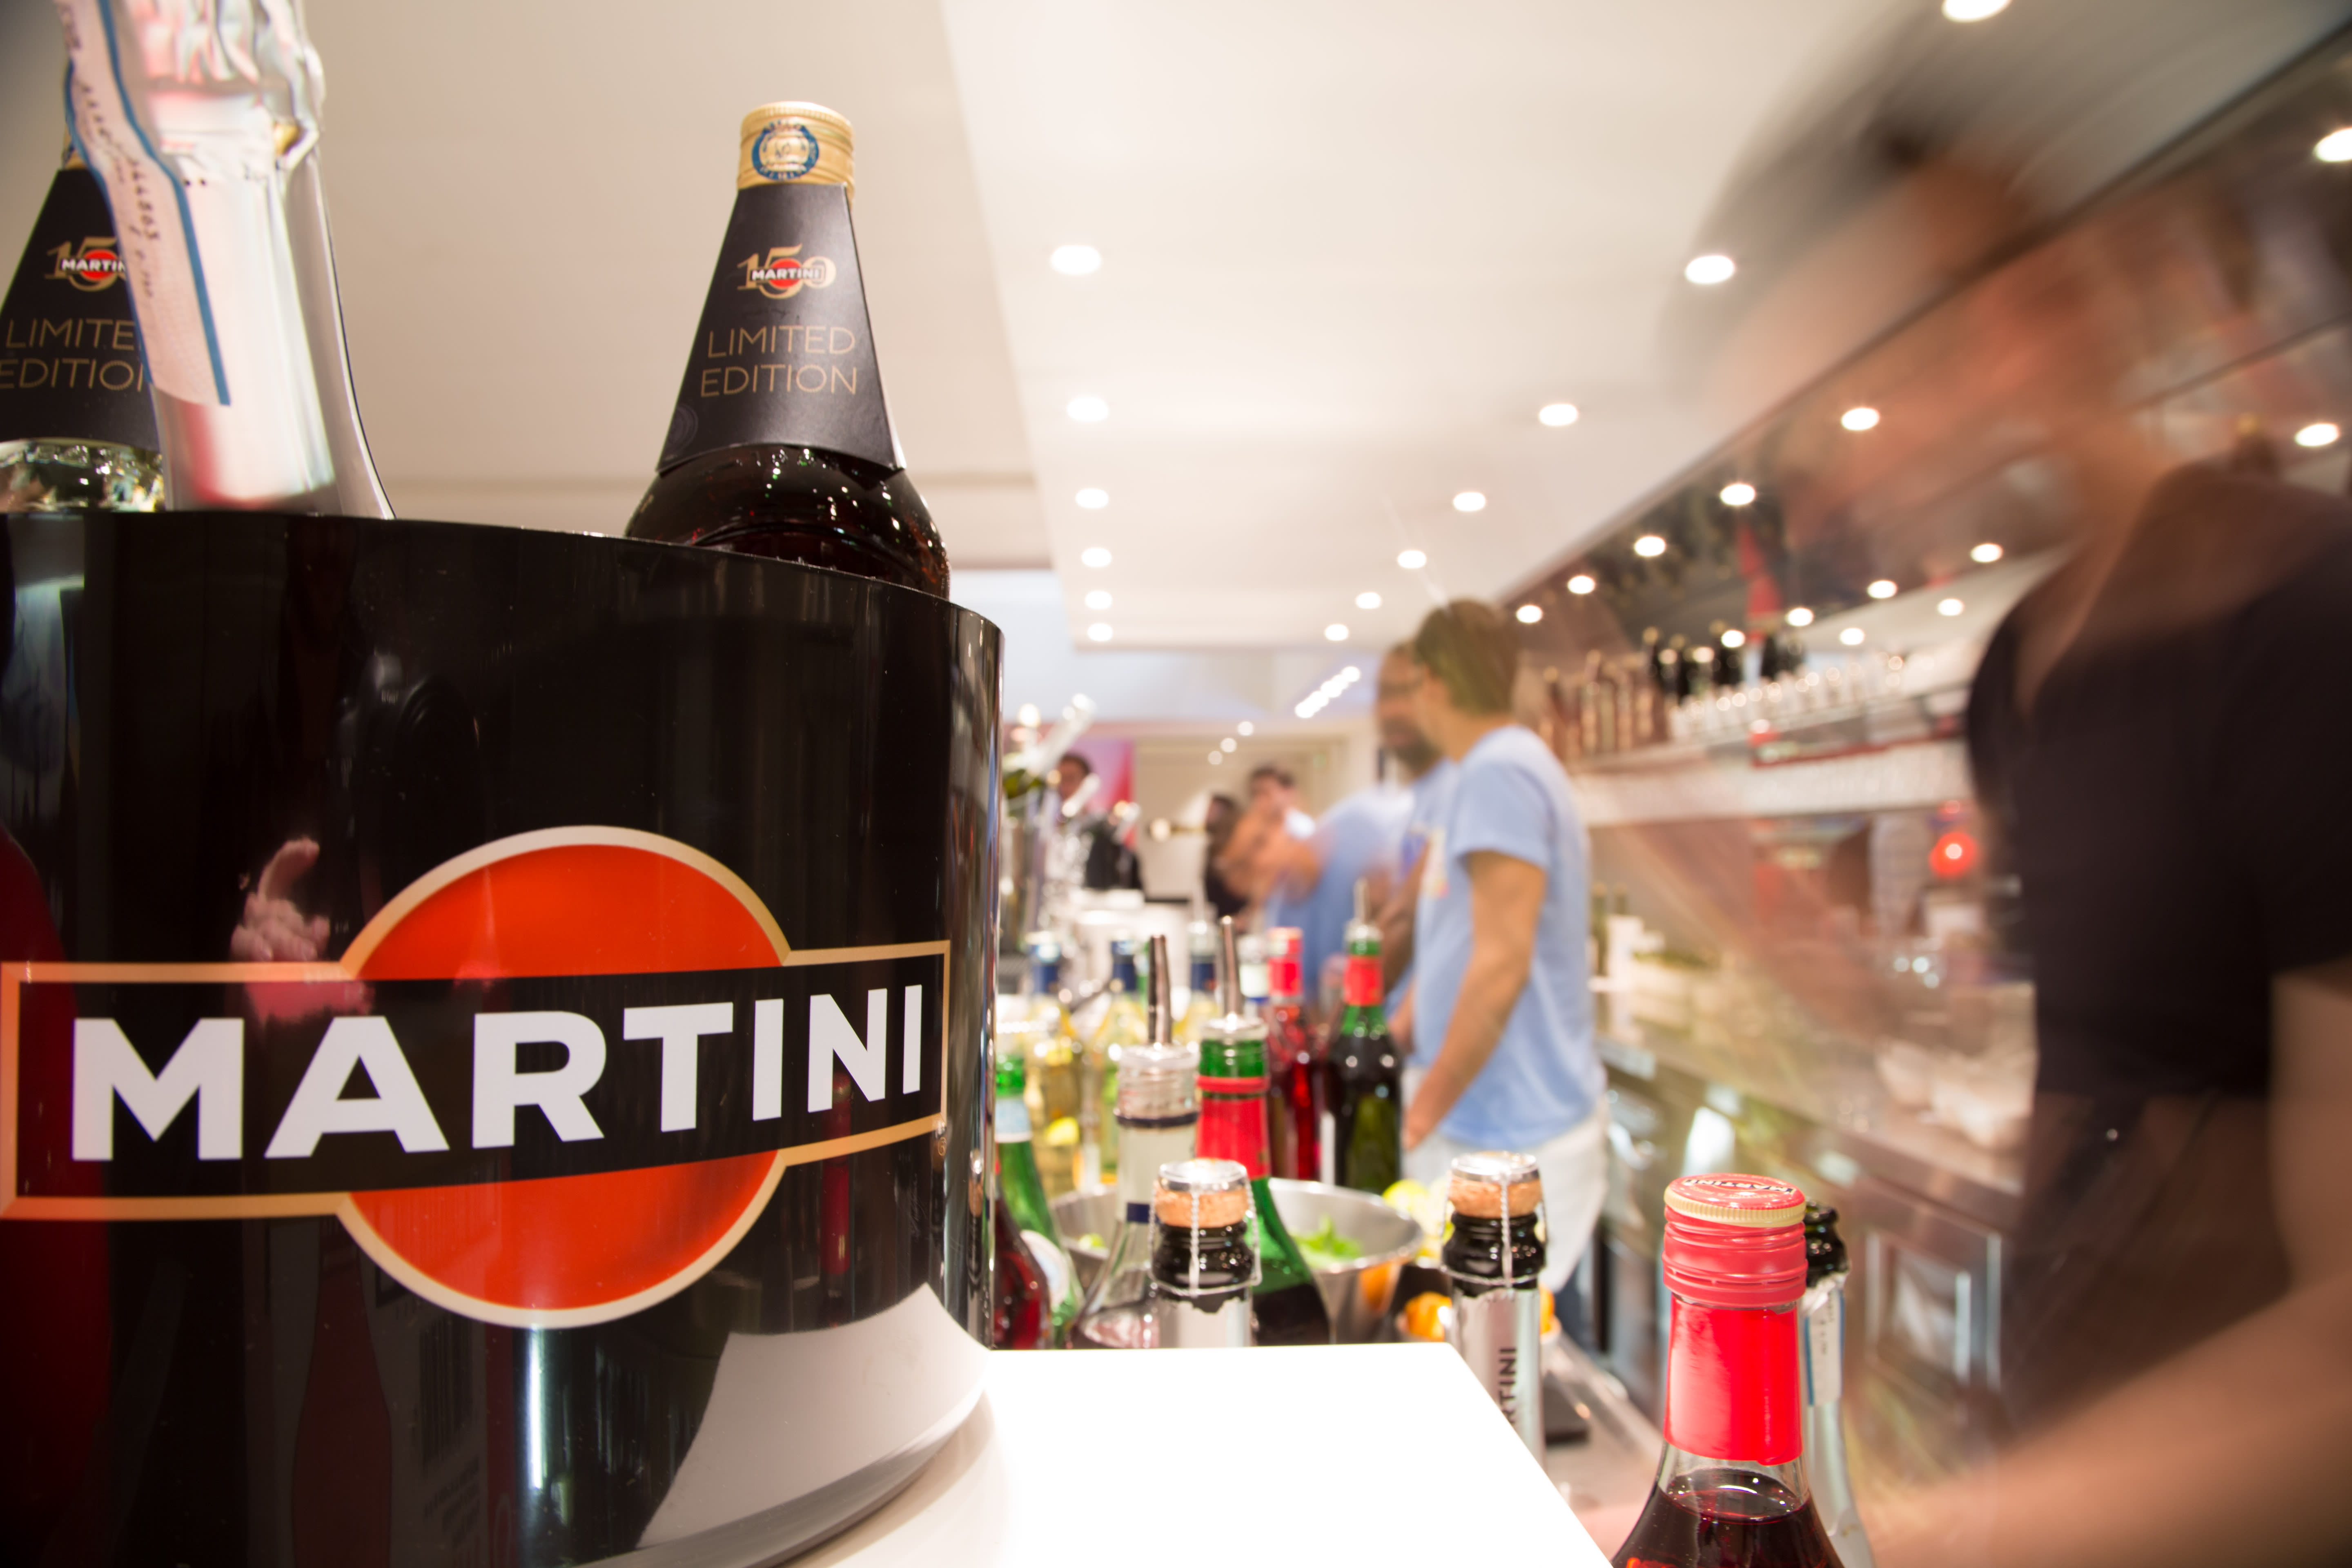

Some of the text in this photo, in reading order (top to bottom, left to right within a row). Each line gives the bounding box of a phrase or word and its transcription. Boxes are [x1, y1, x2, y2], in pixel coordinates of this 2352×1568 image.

[45, 236, 126, 292] 15
[61, 258, 126, 271] MARTIN
[737, 243, 836, 299] 150
[752, 267, 819, 281] MARTINI
[7, 318, 141, 350] LIMITE
[708, 325, 855, 358] LIMITED
[0, 358, 143, 392] EDITIO
[701, 365, 857, 397] EDITION
[72, 984, 922, 1161] MARTINI
[1688, 1179, 1788, 1192] MARTINI
